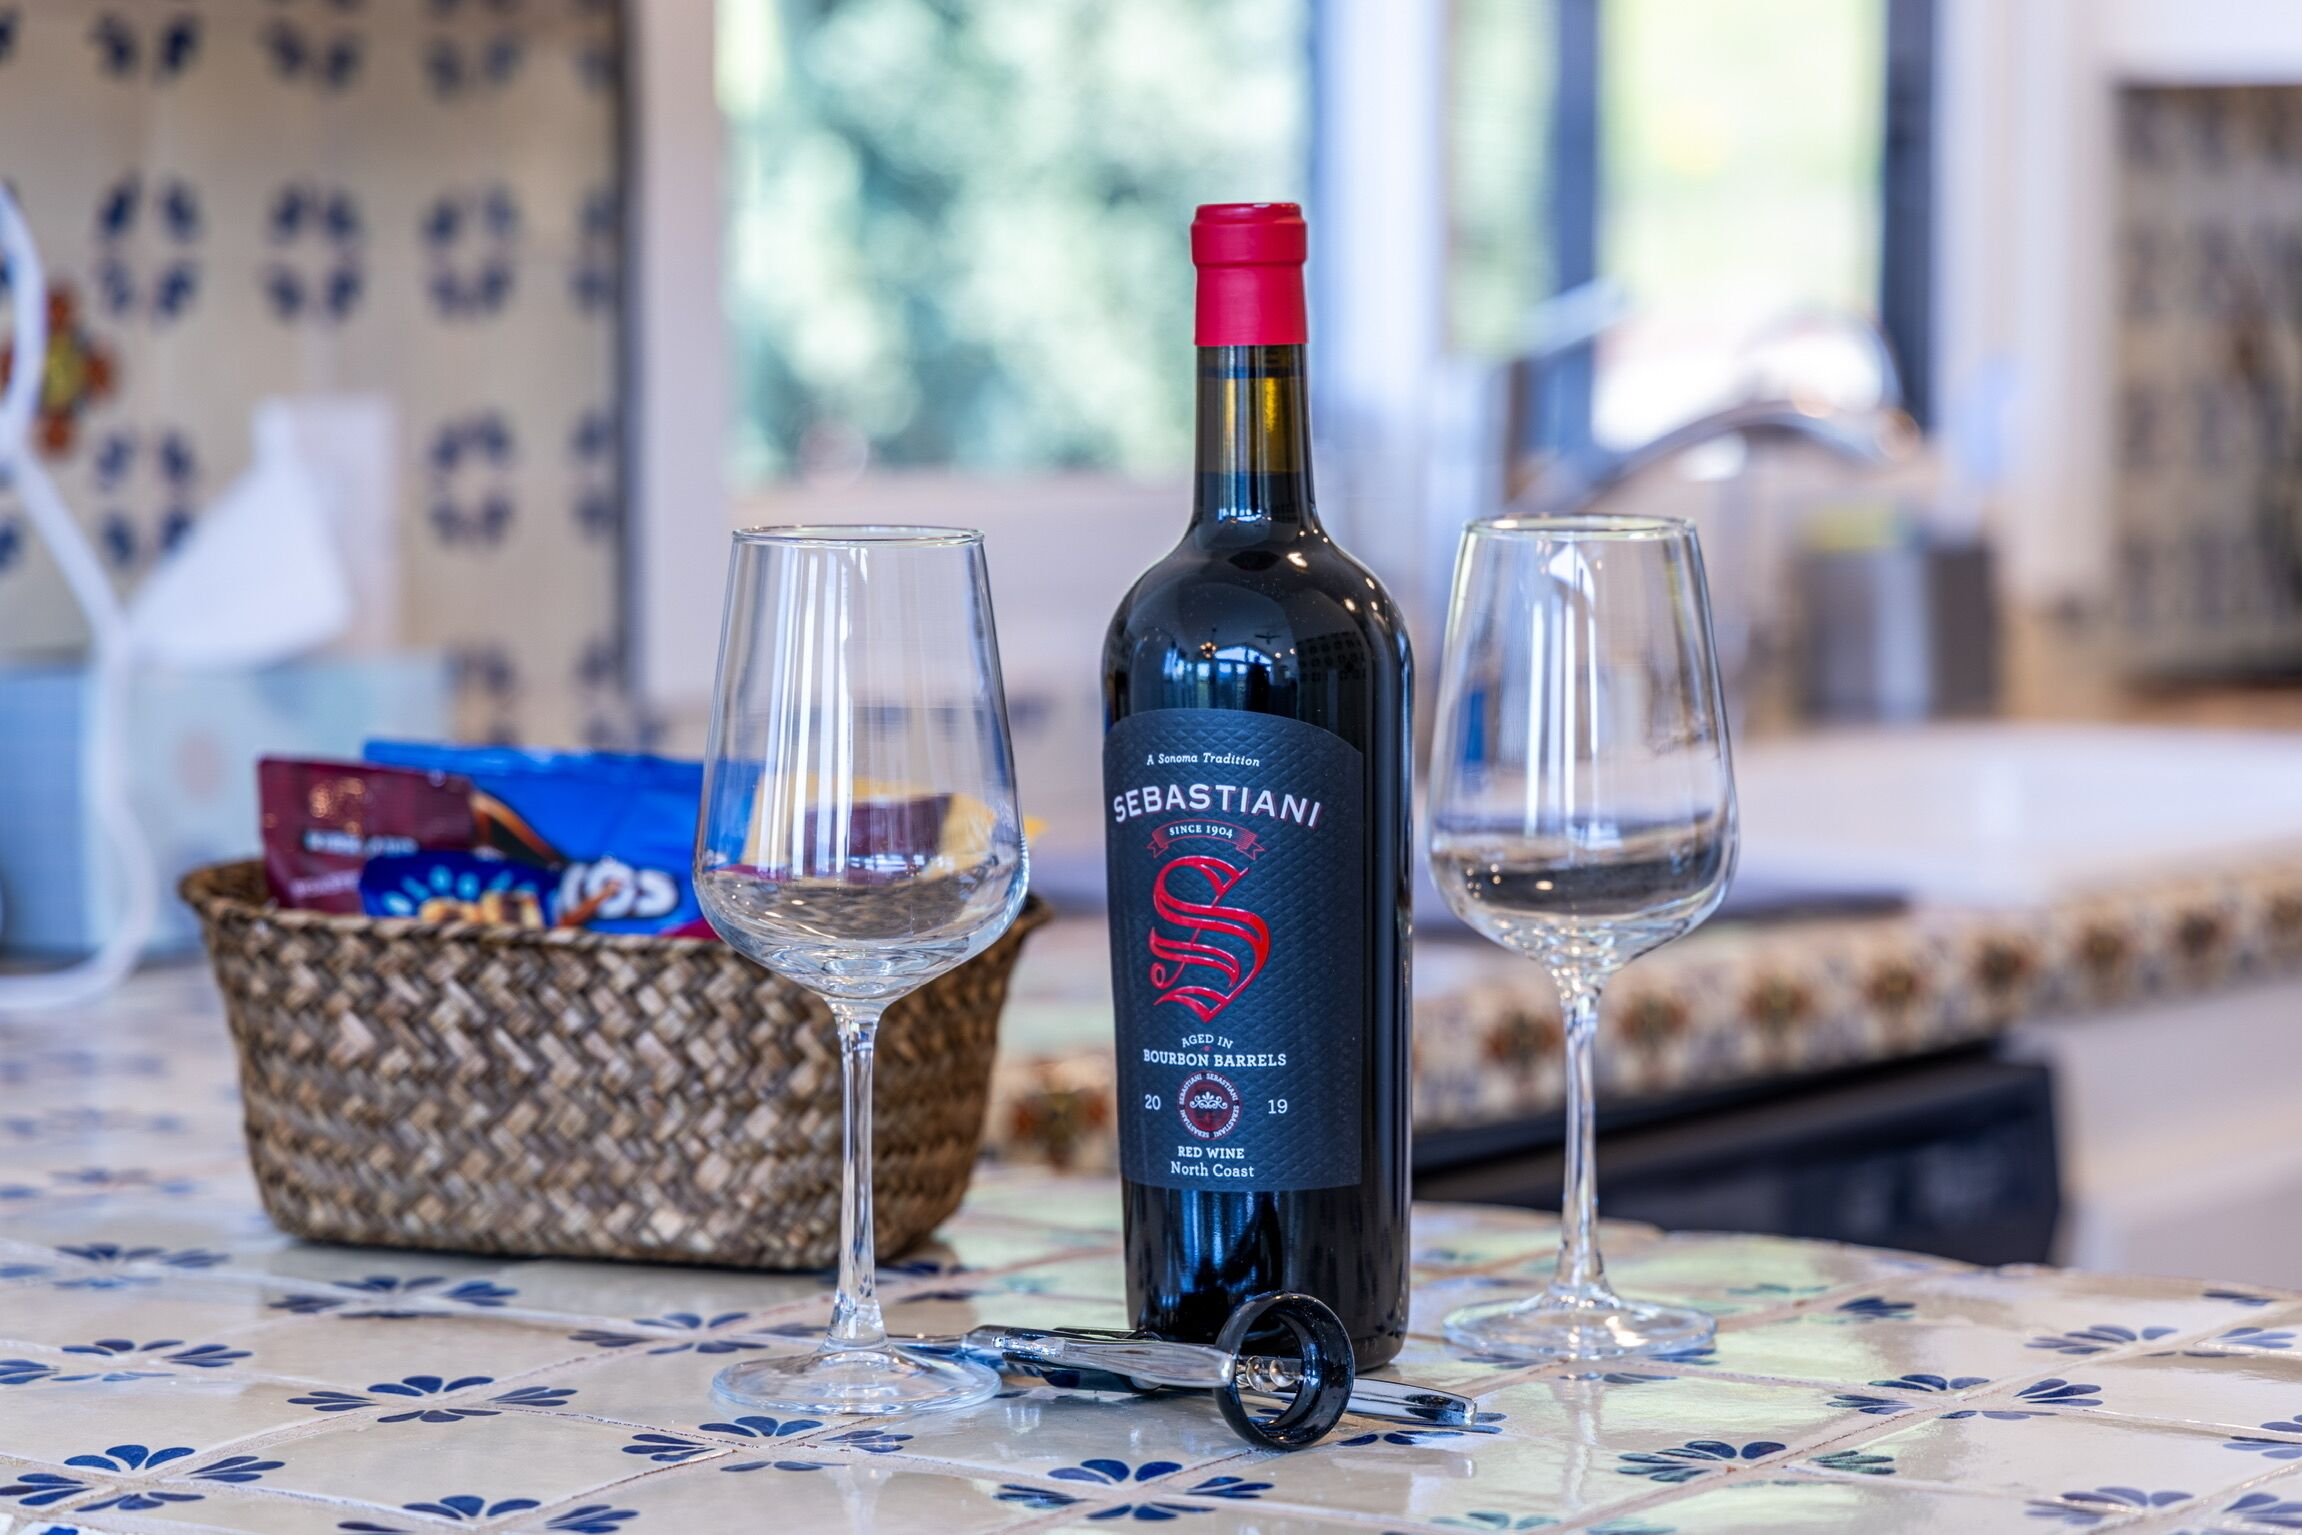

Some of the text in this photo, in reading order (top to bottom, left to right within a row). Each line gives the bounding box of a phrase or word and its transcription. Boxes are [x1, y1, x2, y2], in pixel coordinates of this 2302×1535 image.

[1146, 752, 1260, 767] A Sonoma Tradition
[1113, 783, 1322, 828] SEBASTIANI
[1169, 824, 1233, 838] SINCE 1904
[1181, 1033, 1233, 1049] AGED IN
[1143, 1049, 1287, 1067] BOURBON BARRELS
[1144, 1094, 1288, 1114] 20 19
[1177, 1146, 1245, 1159] RED WINE
[1170, 1161, 1254, 1177] North Coast
